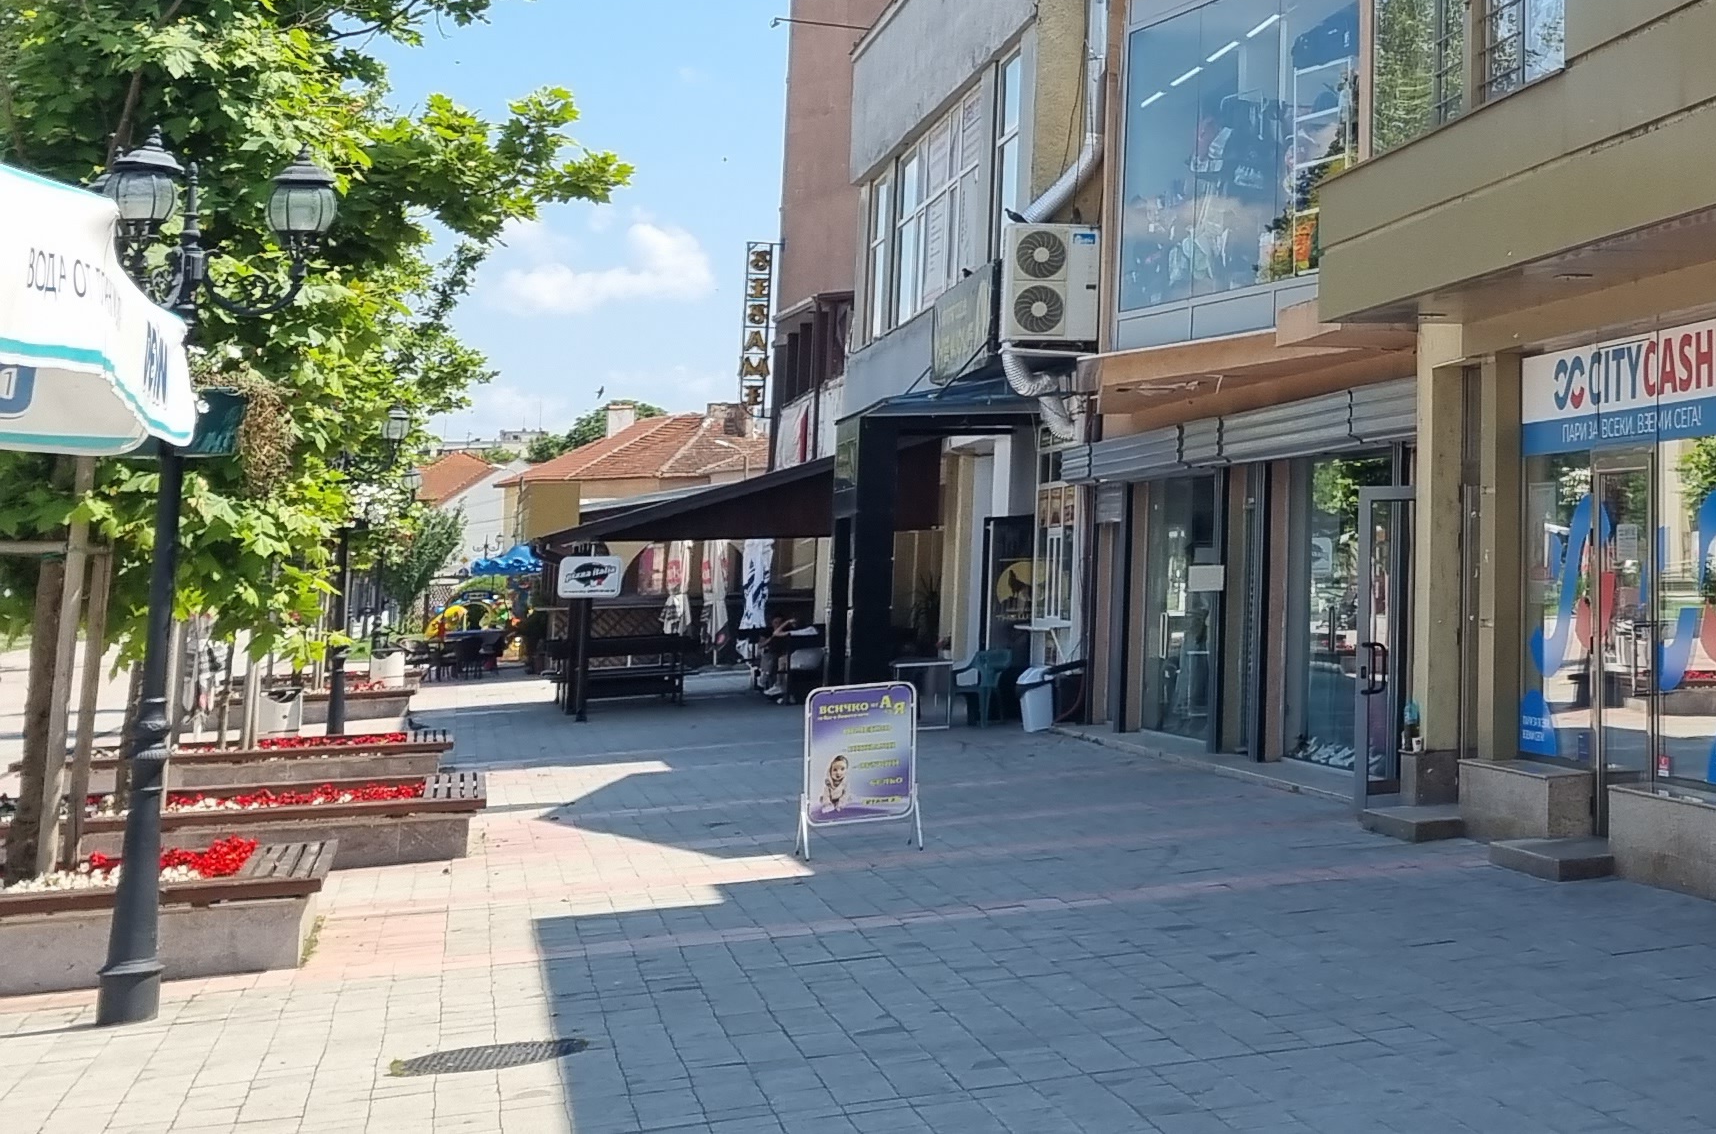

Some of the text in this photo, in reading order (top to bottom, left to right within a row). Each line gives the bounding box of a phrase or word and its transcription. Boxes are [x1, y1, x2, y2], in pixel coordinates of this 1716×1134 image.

[26, 247, 67, 301] ВОДА
[73, 259, 92, 300] ОТ
[738, 249, 771, 407] SESAME
[1562, 422, 1587, 443] ПАРИ
[1587, 422, 1598, 440] ЗА
[1673, 405, 1702, 430] СЕГА!
[564, 564, 617, 583] pizza italia
[818, 702, 869, 715] ВСИЧКО
